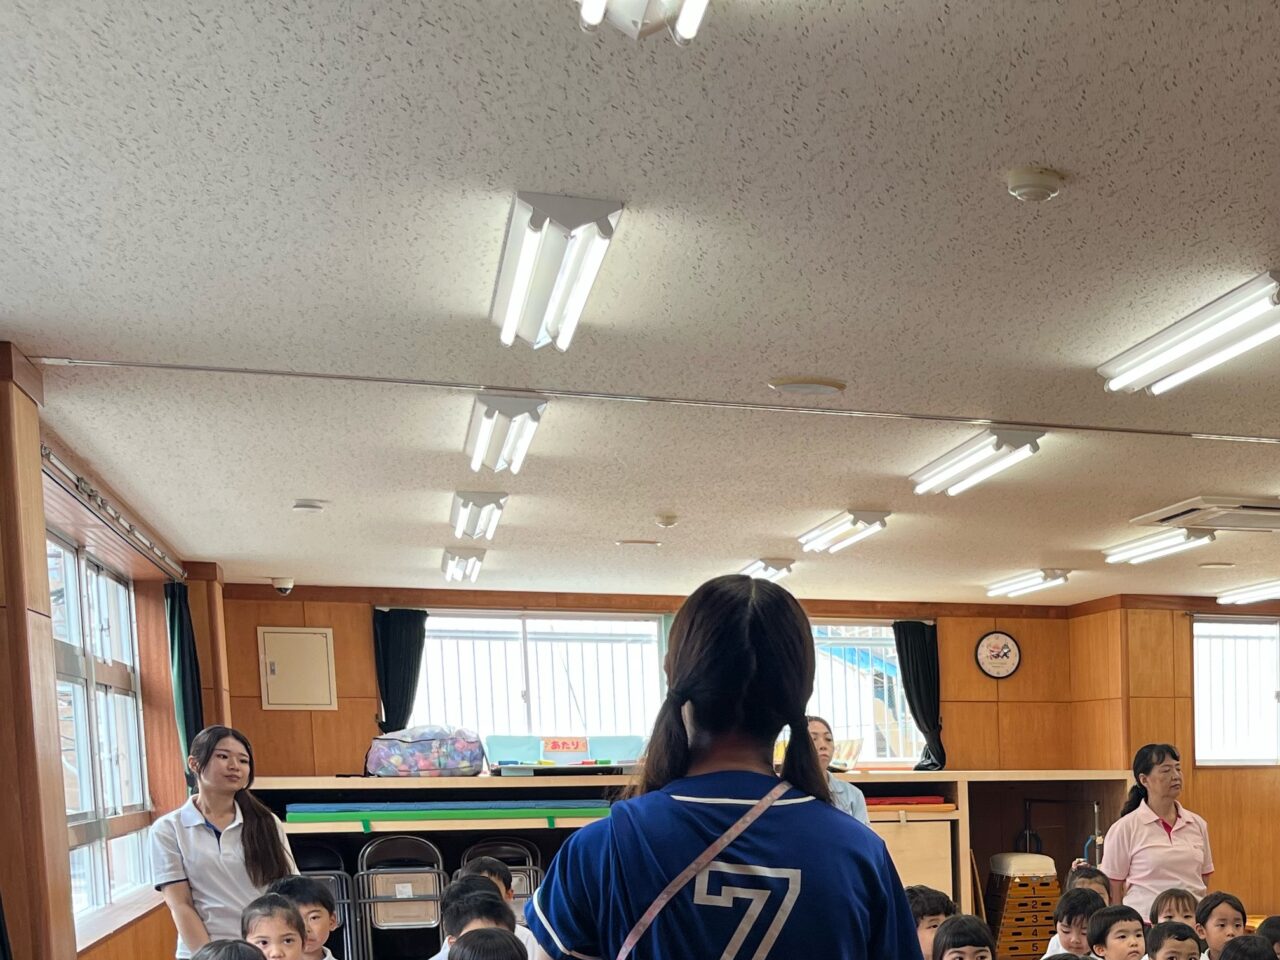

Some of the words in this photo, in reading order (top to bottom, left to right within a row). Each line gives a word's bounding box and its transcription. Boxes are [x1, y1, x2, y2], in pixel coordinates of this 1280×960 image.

[551, 741, 579, 750] あたり
[1031, 900, 1038, 909] 2
[1031, 914, 1039, 924] 3
[1031, 928, 1038, 937] 4
[1032, 943, 1039, 952] 5
